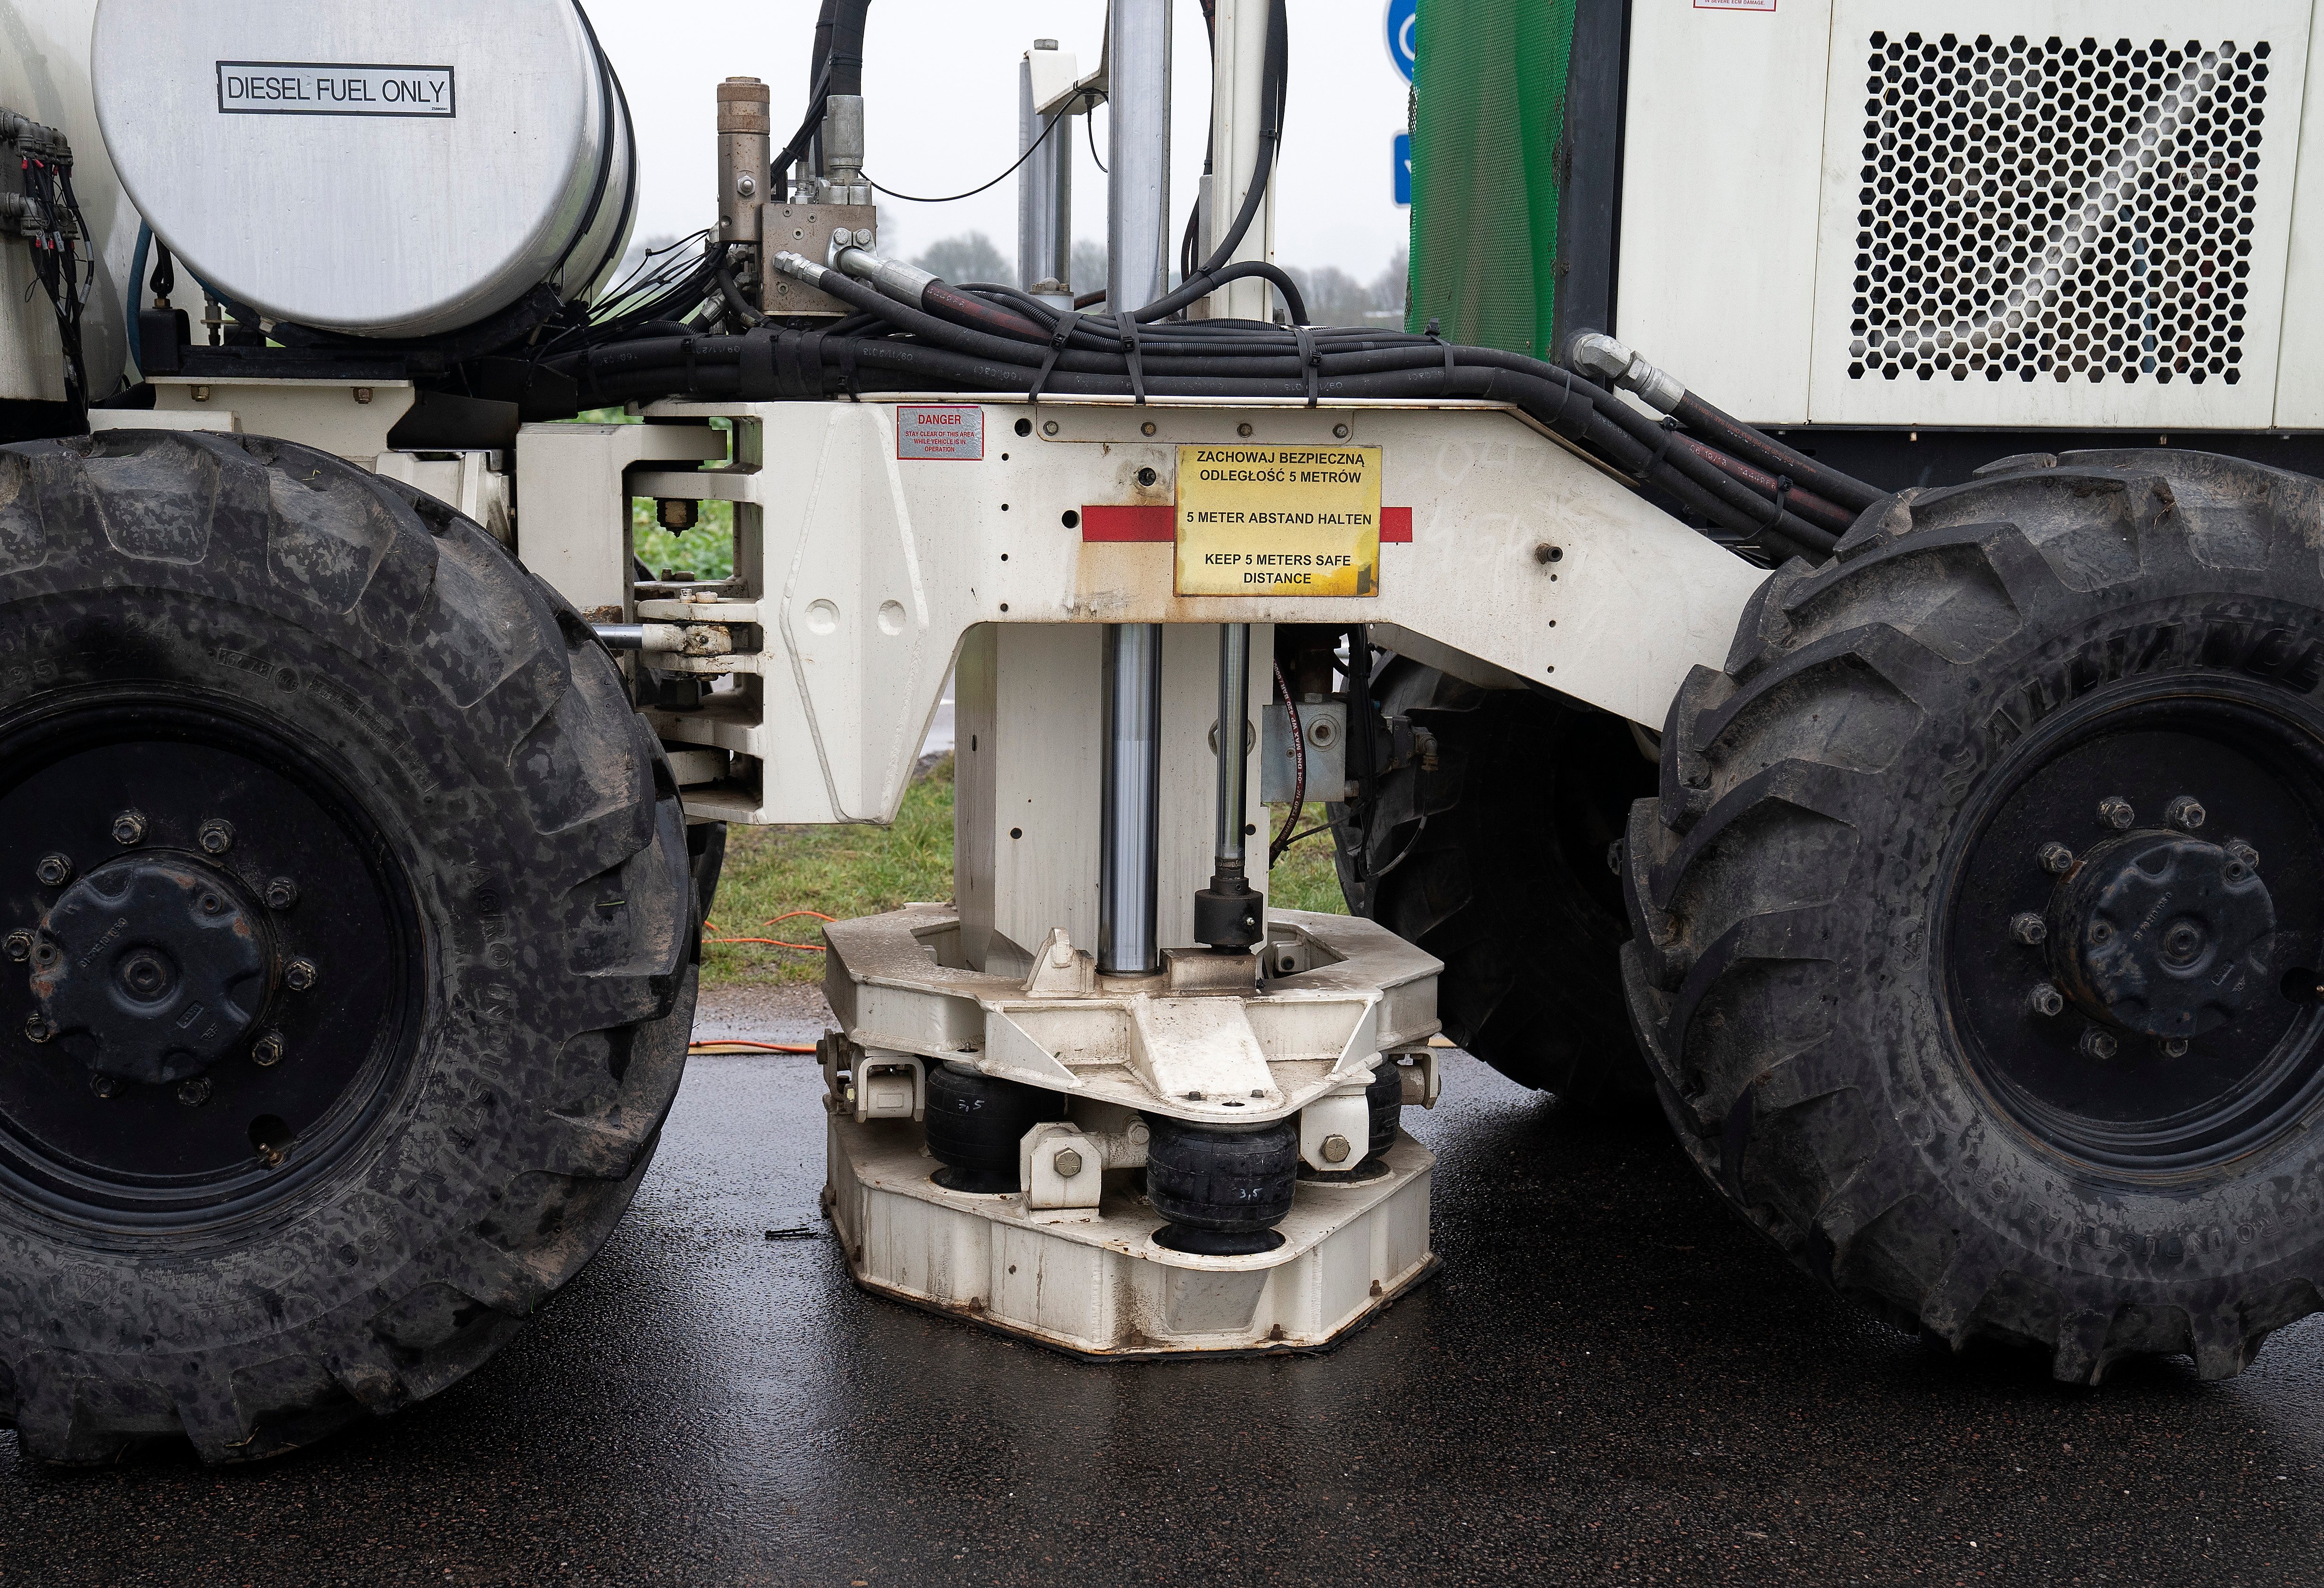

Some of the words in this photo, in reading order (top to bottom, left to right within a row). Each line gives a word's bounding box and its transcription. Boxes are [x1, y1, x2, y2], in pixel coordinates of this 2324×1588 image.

[227, 76, 310, 100] DIESEL
[316, 78, 376, 101] FUEL
[382, 79, 445, 103] ONLY
[918, 414, 961, 424] DANGER
[1713, 415, 1726, 425] SAE
[1739, 430, 1753, 441] MAX
[1752, 438, 1762, 446] PSI
[1197, 451, 1275, 463] ZACHOWAJ
[1279, 452, 1365, 467] BEZPIECZNĄ
[1200, 468, 1285, 482] ODLEGŁOŚĆ
[1289, 471, 1296, 482] 5
[1300, 469, 1361, 483] METRÓW
[1187, 512, 1194, 523] 5
[1198, 512, 1245, 523] METER
[1248, 513, 1314, 524] ABSTAND
[1318, 514, 1372, 525] HALTEN
[1205, 554, 1241, 565] KEEP
[1245, 554, 1253, 565] 5
[1257, 554, 1311, 566] METERS
[1316, 555, 1352, 566] SAFE
[1244, 572, 1312, 584] DISTANCE
[1280, 684, 1289, 700] BAR
[1981, 619, 2324, 771] ALLIANCE
[1291, 717, 1297, 729] WP
[467, 861, 511, 968] AGRO
[959, 1099, 985, 1112] 3,5
[1239, 1188, 1263, 1200] 3,5
[2235, 1196, 2322, 1245] AGRO
[338, 1213, 401, 1267] 580
